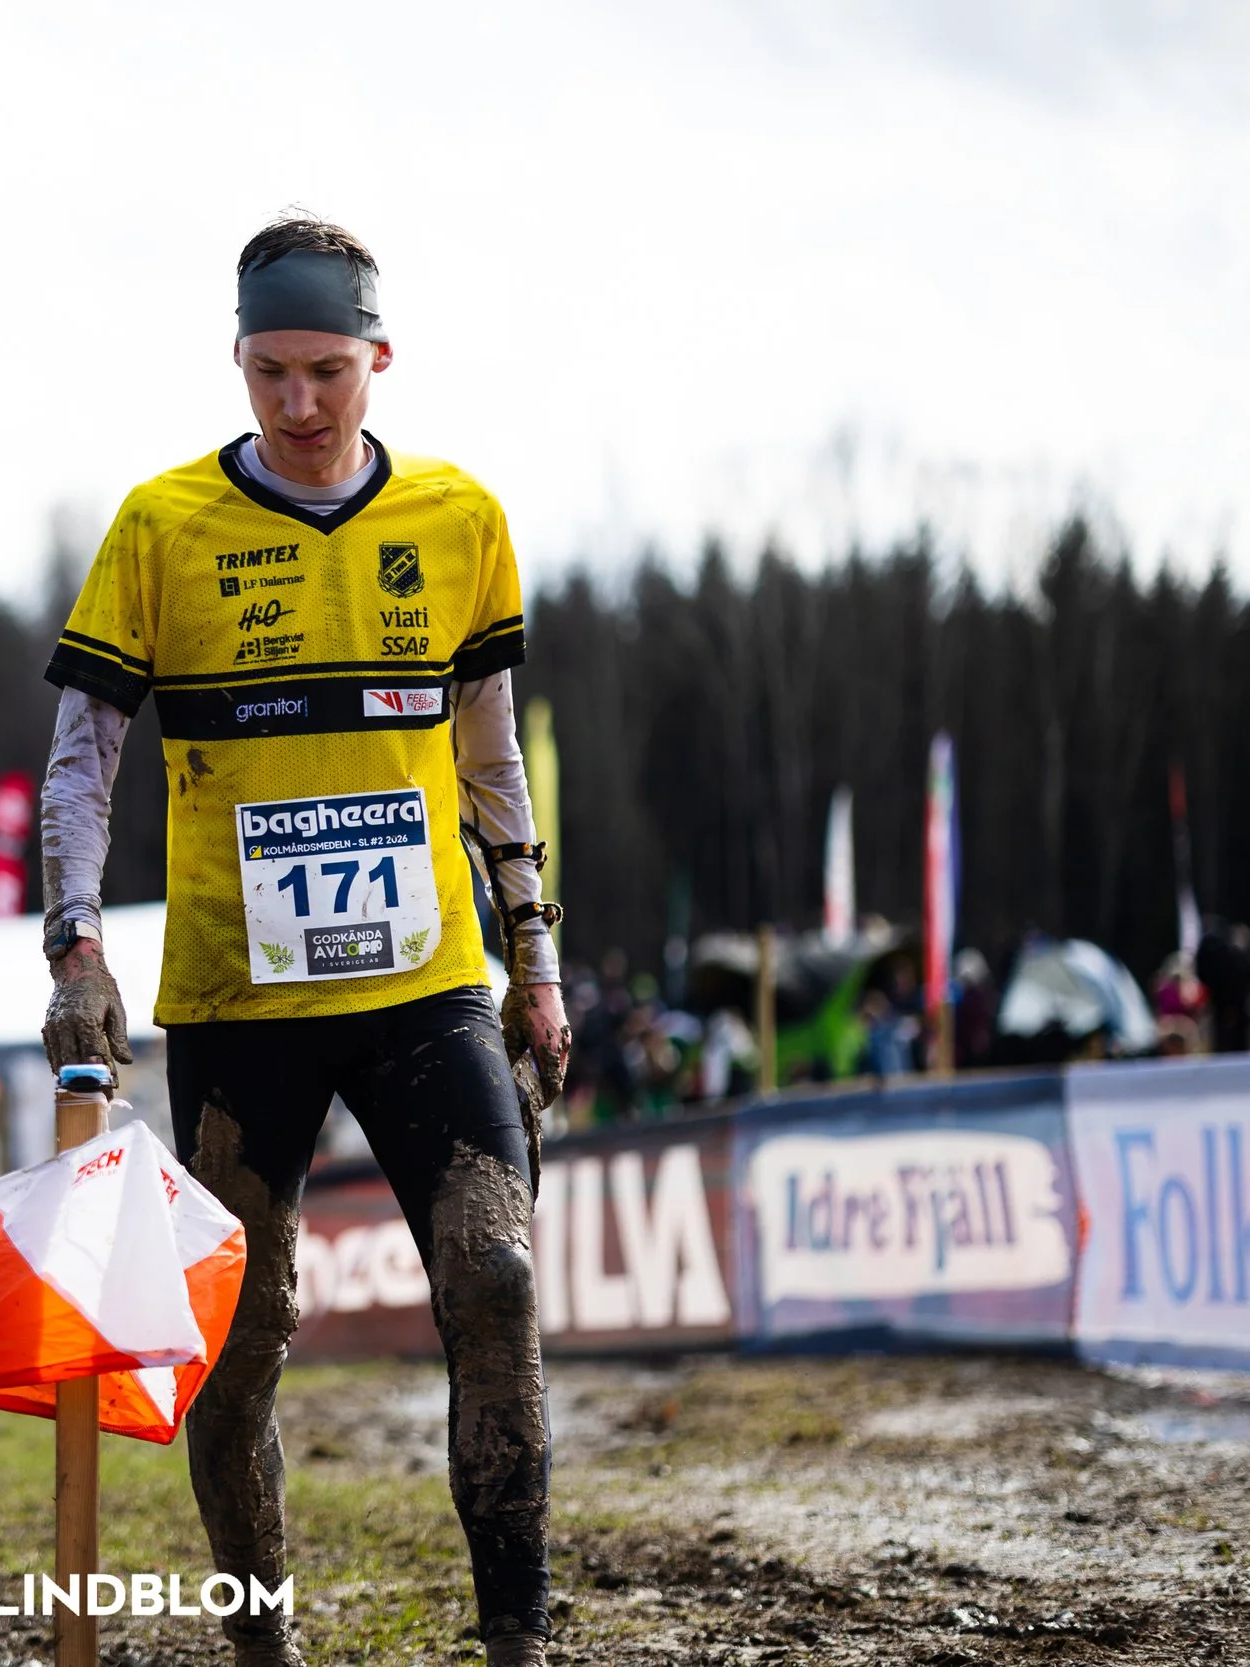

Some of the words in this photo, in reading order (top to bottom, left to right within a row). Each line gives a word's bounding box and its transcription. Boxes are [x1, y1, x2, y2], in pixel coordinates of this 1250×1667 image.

[215, 543, 300, 571] TRIMTEX
[243, 579, 258, 590] LF
[259, 574, 306, 588] Dalarnas
[379, 605, 429, 628] viati
[380, 636, 430, 656] SSAB
[236, 697, 303, 722] granitor
[244, 801, 423, 838] bagheera
[263, 840, 351, 856] KOLMÅRDSMEDELN
[358, 838, 370, 847] SL
[370, 836, 384, 846] #2
[386, 834, 408, 844] 2026
[277, 856, 400, 917] 171
[312, 929, 384, 945] GODKÄNDA
[330, 959, 365, 967] SVERIGE
